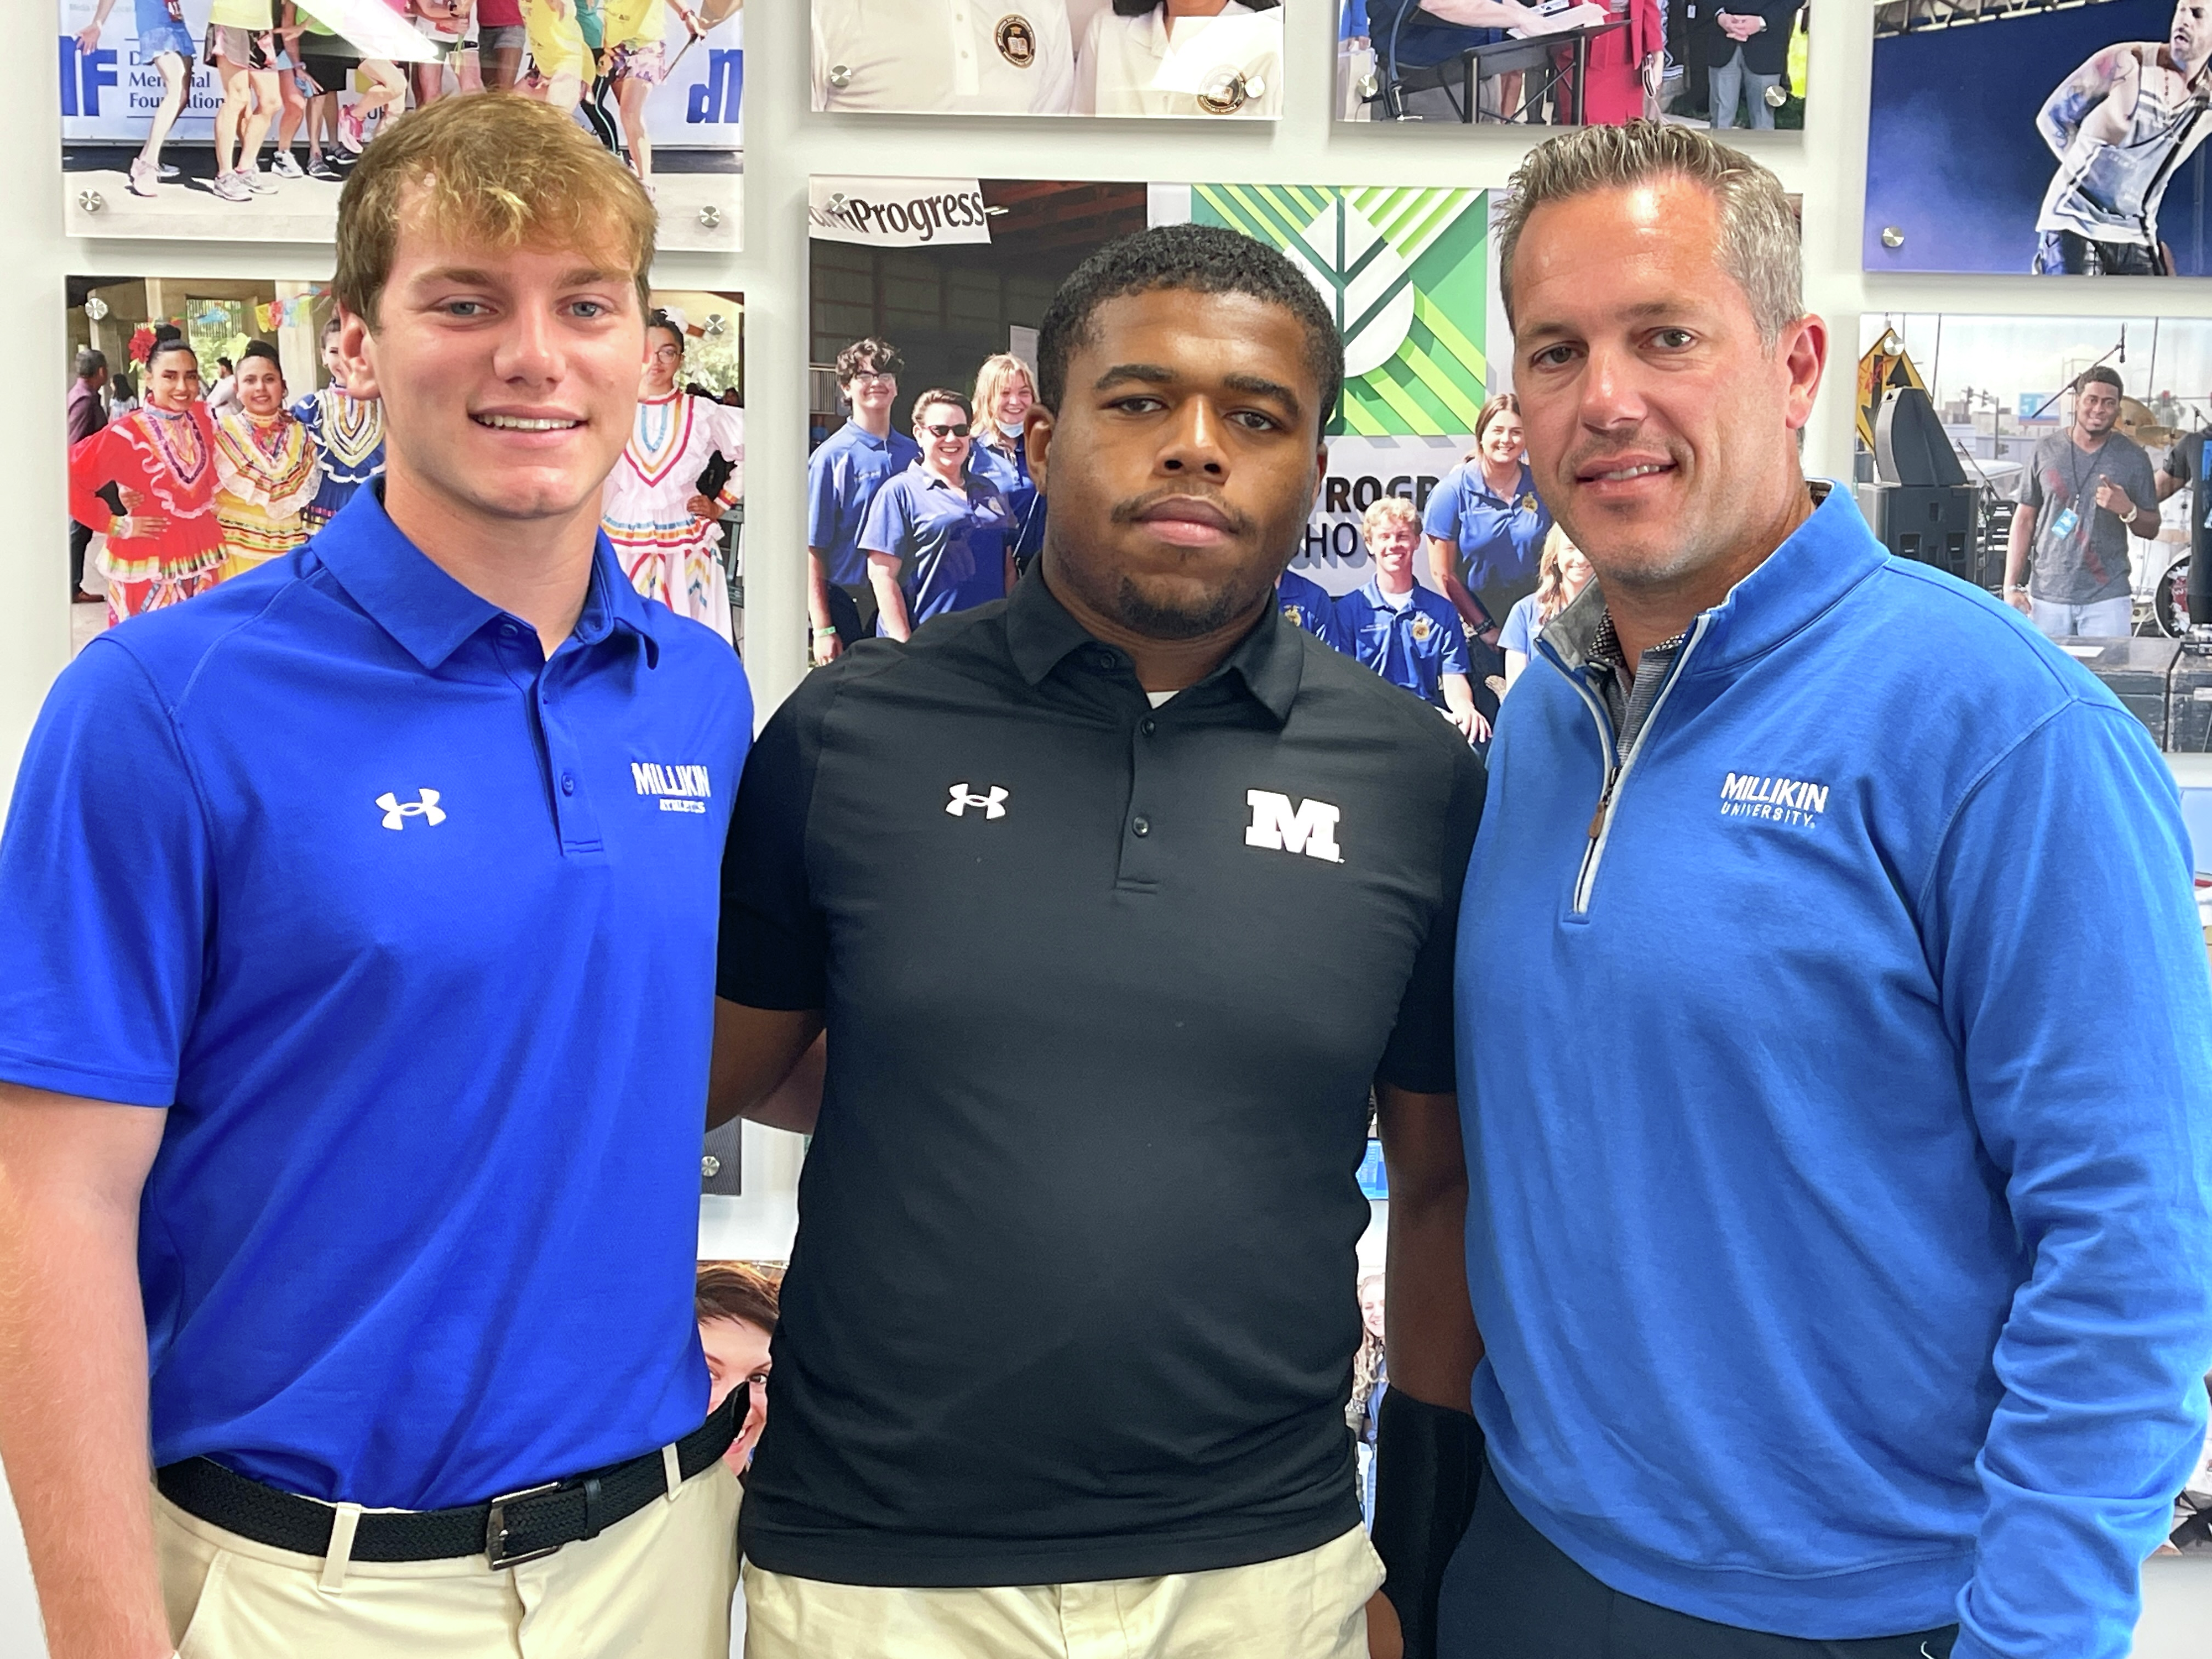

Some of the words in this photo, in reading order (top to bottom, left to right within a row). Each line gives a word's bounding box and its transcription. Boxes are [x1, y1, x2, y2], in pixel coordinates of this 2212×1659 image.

[631, 762, 711, 797] MILLIKIN
[1720, 773, 1829, 813] MILLIKIN
[1245, 789, 1339, 863] M
[1721, 801, 1813, 827] UNIVERSITY
